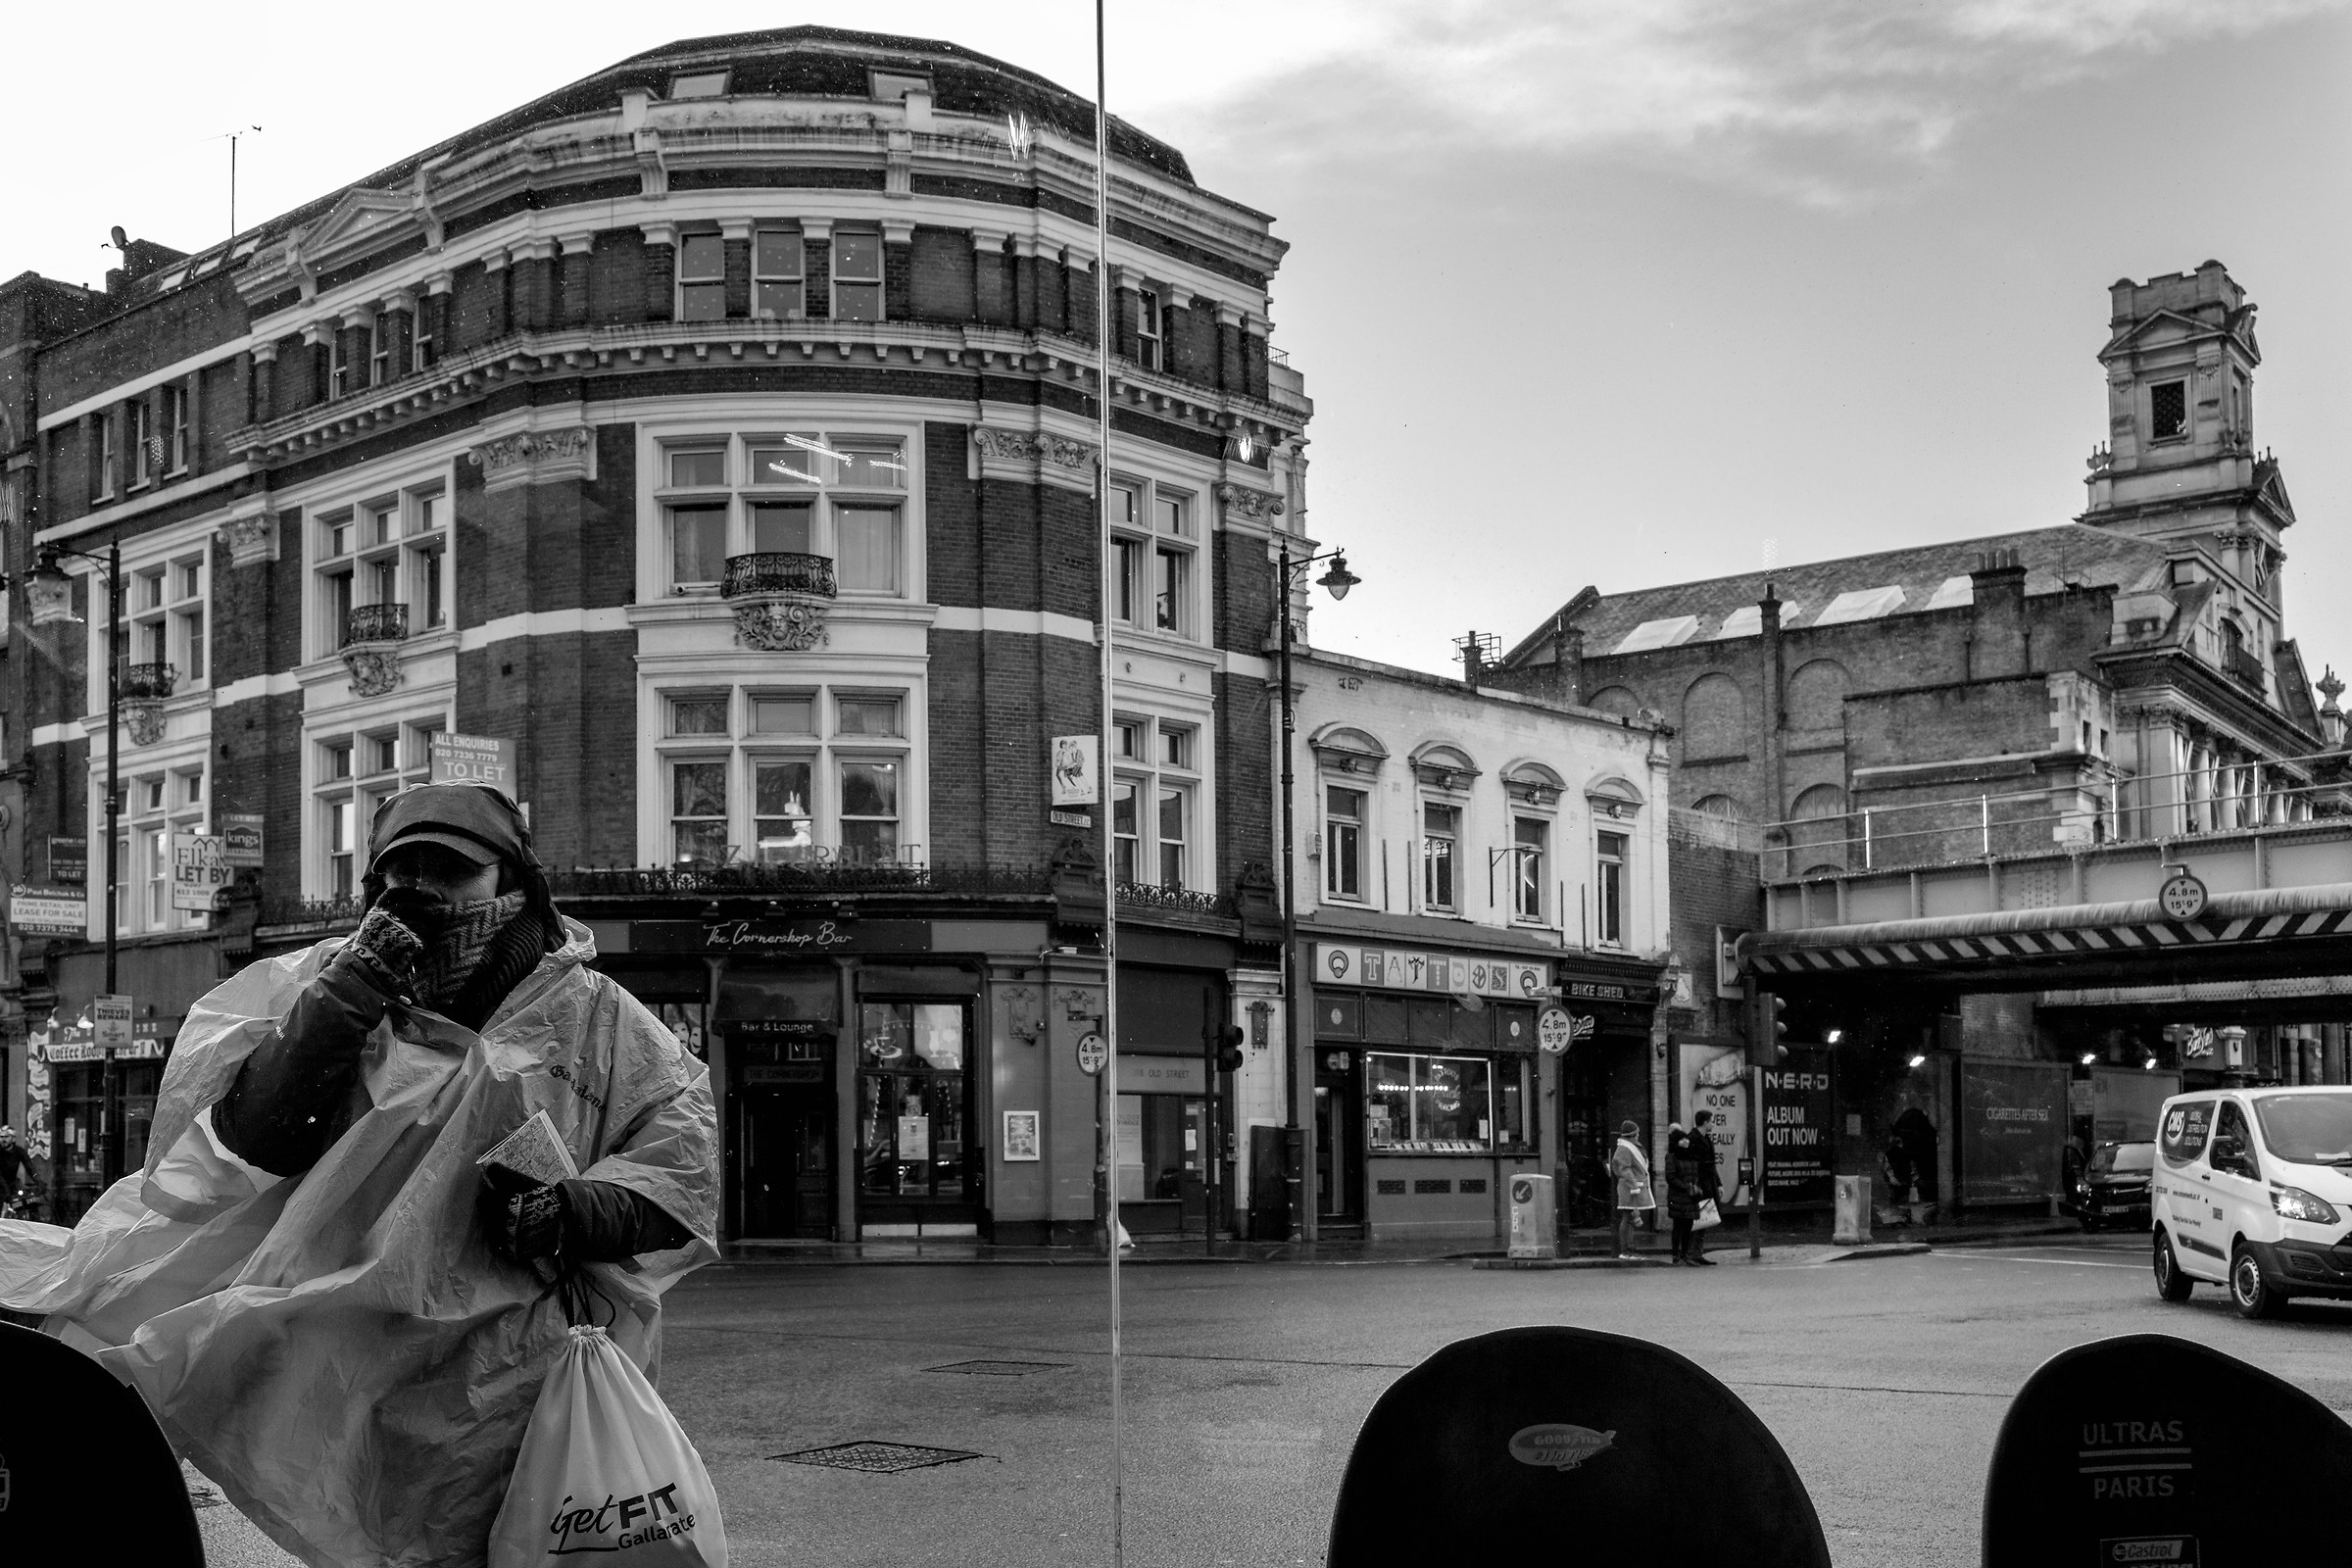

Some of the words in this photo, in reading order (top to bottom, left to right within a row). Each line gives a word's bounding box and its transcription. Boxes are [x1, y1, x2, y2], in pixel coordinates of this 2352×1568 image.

[435, 734, 452, 746] ALL
[453, 736, 500, 752] ENQUIRIES
[434, 748, 452, 758] 020
[444, 761, 467, 777] TO
[472, 764, 507, 782] LET
[227, 831, 259, 848] kings
[175, 864, 205, 883] LET
[209, 867, 231, 884] BY
[14, 907, 41, 916] LEASE
[42, 909, 62, 918] FOR
[63, 910, 85, 919] SALE
[703, 921, 731, 947] The
[732, 922, 814, 948] Cornershop
[816, 920, 854, 945] Bar
[1571, 983, 1595, 997] BIKE
[742, 1021, 760, 1030] Bar
[773, 1022, 813, 1033] Lounge
[1542, 1018, 1566, 1029] 4.8m
[1706, 1095, 1718, 1107] NO
[1719, 1095, 1736, 1108] ONE
[1766, 1105, 1805, 1125] ALBUM
[1767, 1128, 1790, 1146] OUT
[1791, 1128, 1819, 1146] NOW
[2082, 1420, 2183, 1446] ULTRAS
[2093, 1475, 2176, 1499] PARIS
[617, 1513, 697, 1549] Gallarate
[2127, 1543, 2175, 1559] Castrol
